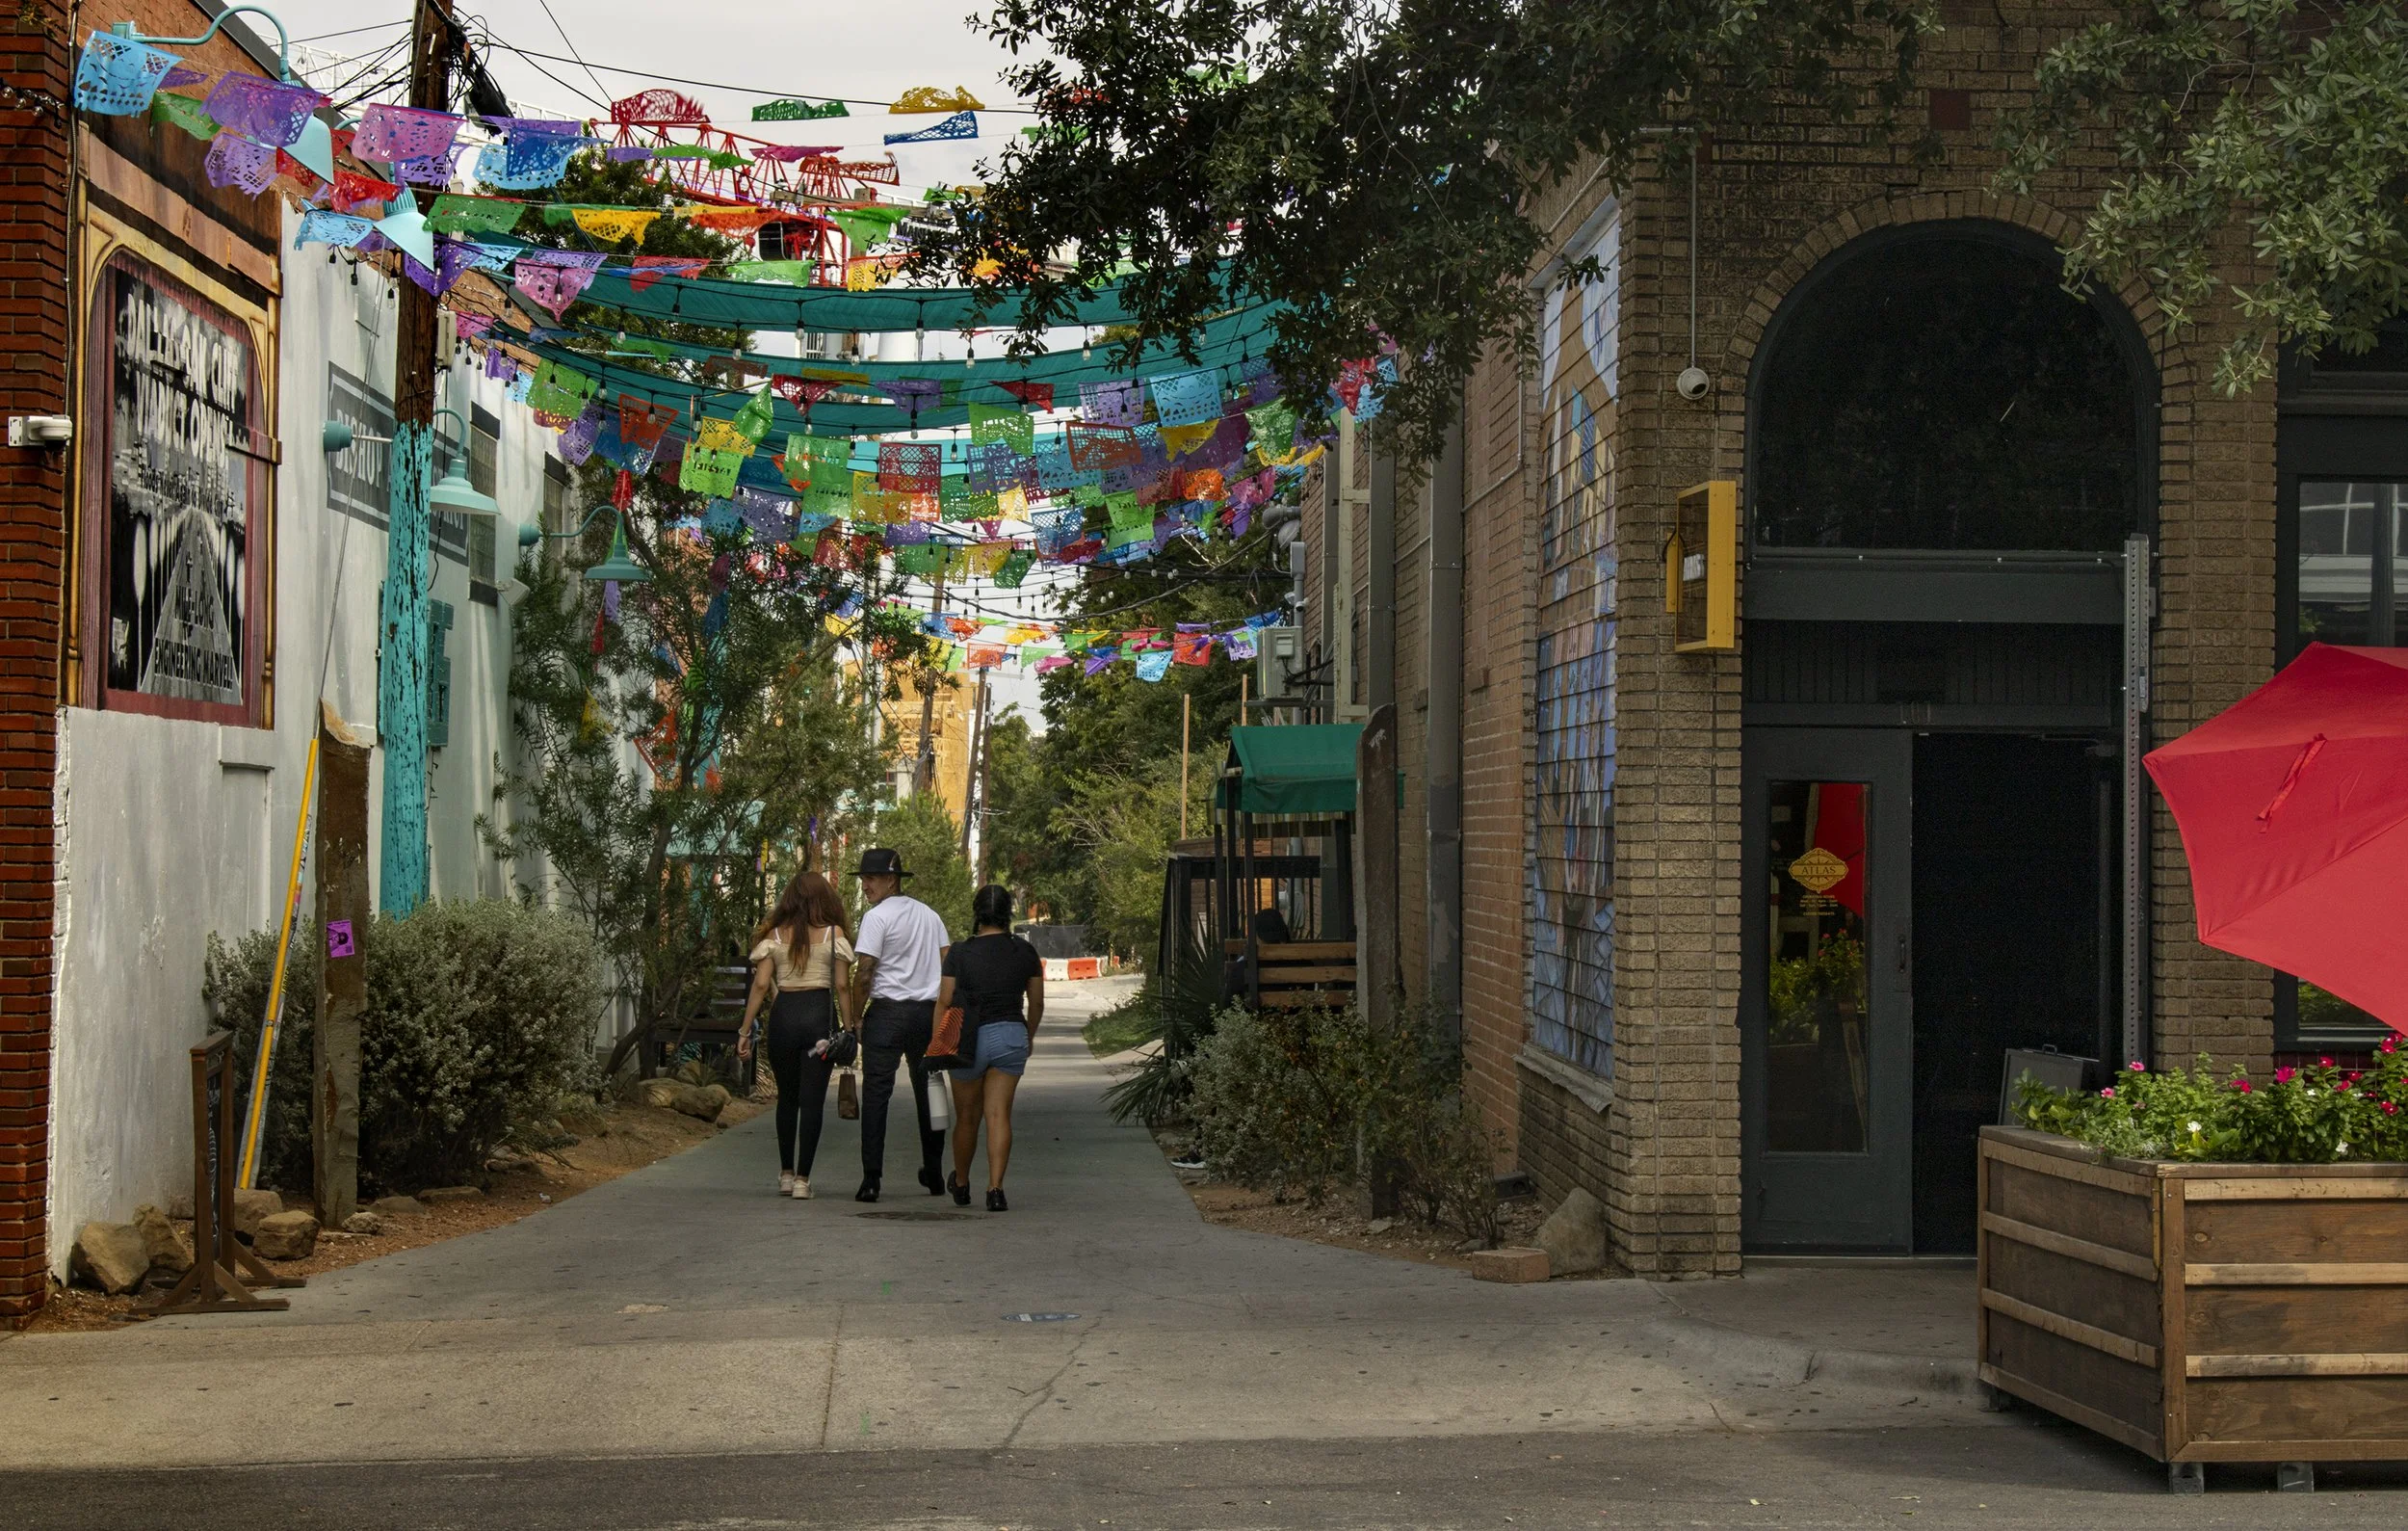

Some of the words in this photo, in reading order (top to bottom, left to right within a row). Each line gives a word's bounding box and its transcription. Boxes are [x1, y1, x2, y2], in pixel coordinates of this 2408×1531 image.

[212, 342, 238, 414] CLIFF
[137, 371, 188, 454] VIADUCT
[154, 637, 200, 682] ENGINEERING
[1801, 865, 1836, 875] ATLAS
